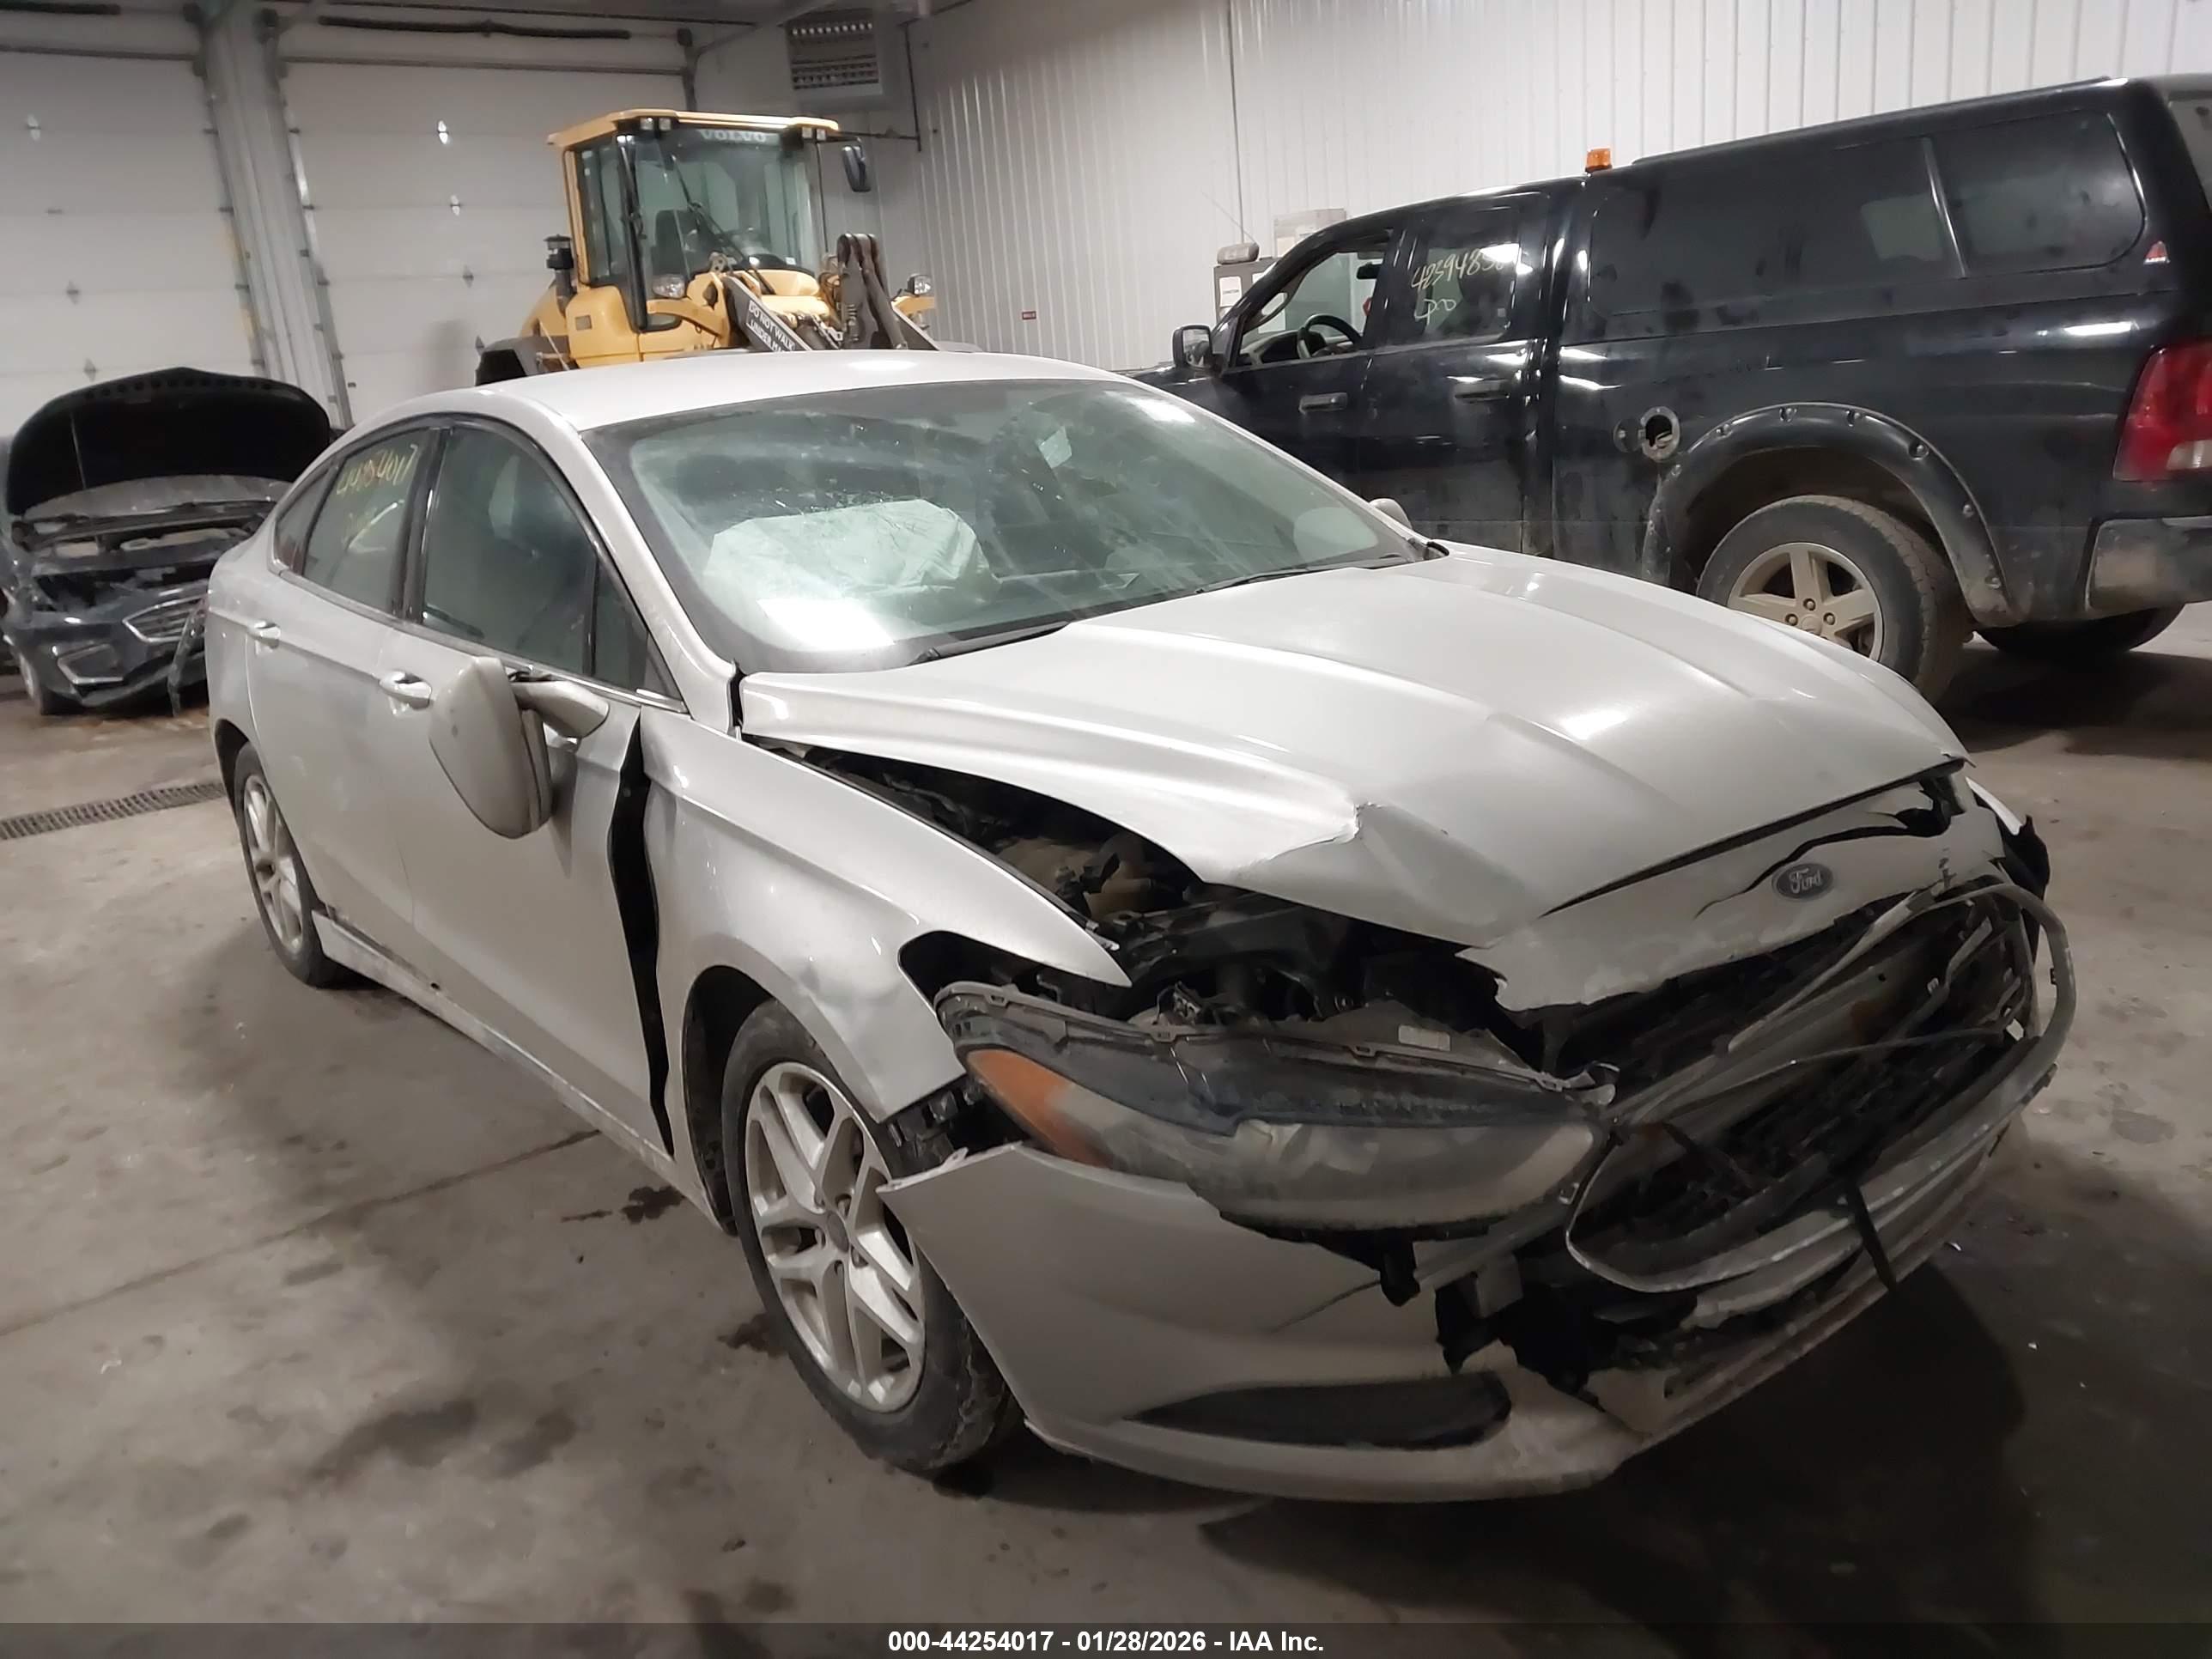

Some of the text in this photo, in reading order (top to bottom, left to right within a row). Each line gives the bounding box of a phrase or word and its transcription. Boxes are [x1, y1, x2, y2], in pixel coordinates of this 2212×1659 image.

[696, 129, 766, 143] VOLVO
[748, 300, 760, 318] DO
[760, 313, 775, 332] NOT
[1789, 867, 1822, 894] Ford
